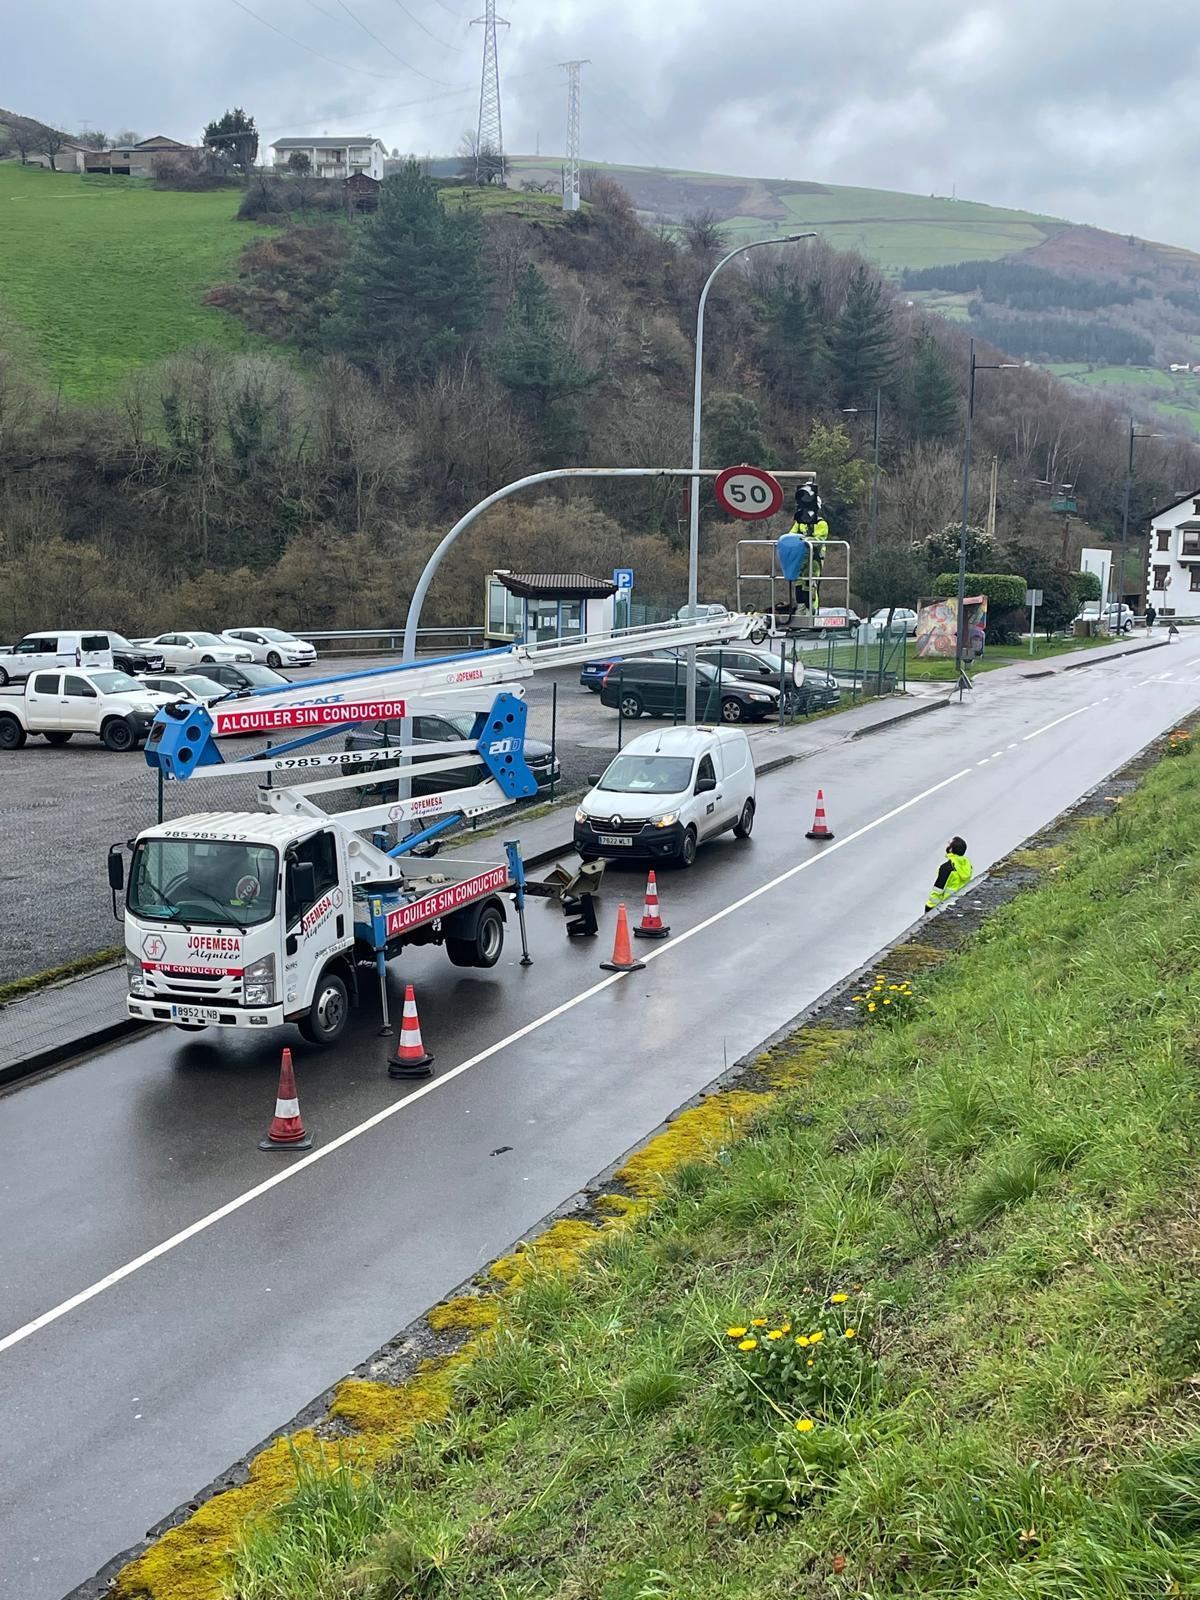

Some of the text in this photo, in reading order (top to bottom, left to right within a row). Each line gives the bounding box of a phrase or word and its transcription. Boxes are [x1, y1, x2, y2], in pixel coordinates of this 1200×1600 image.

[730, 484, 767, 504] 50
[618, 573, 630, 587] P
[456, 669, 483, 683] JOFEMESA
[222, 702, 402, 732] ALQUILER SIN CONDUCTOR
[284, 749, 403, 768] 985 985 212
[410, 796, 443, 811] JOFEMESA
[164, 830, 248, 841] 985 985 212
[391, 869, 504, 931] ALQUILER SIN CONDUCTOR
[187, 935, 240, 952] JOFEMESA
[188, 948, 240, 962] Alquiler
[155, 963, 229, 976] SIN CONDUCTOR
[178, 1006, 218, 1020] 8952 LNB
